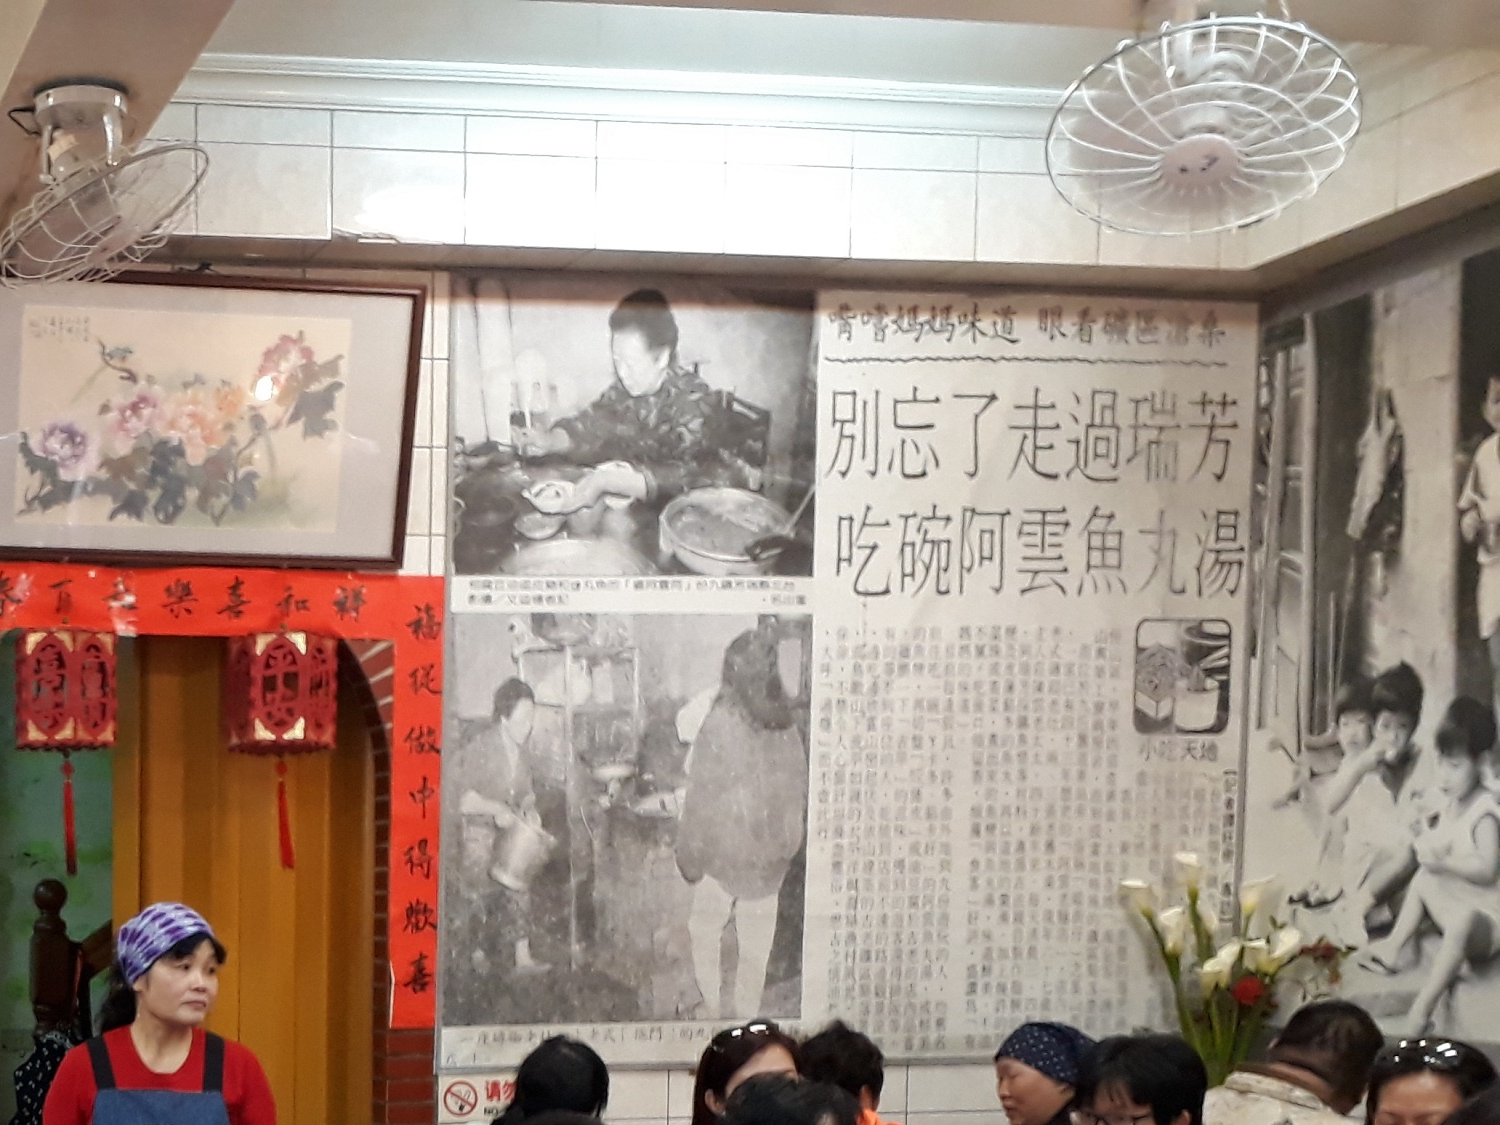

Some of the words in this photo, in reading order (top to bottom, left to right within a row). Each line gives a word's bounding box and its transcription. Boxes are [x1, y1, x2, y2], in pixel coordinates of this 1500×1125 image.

[824, 387, 1239, 483] 別忘了走過瑞芳
[835, 503, 1246, 598] 吃碗阿雲魚丸湯
